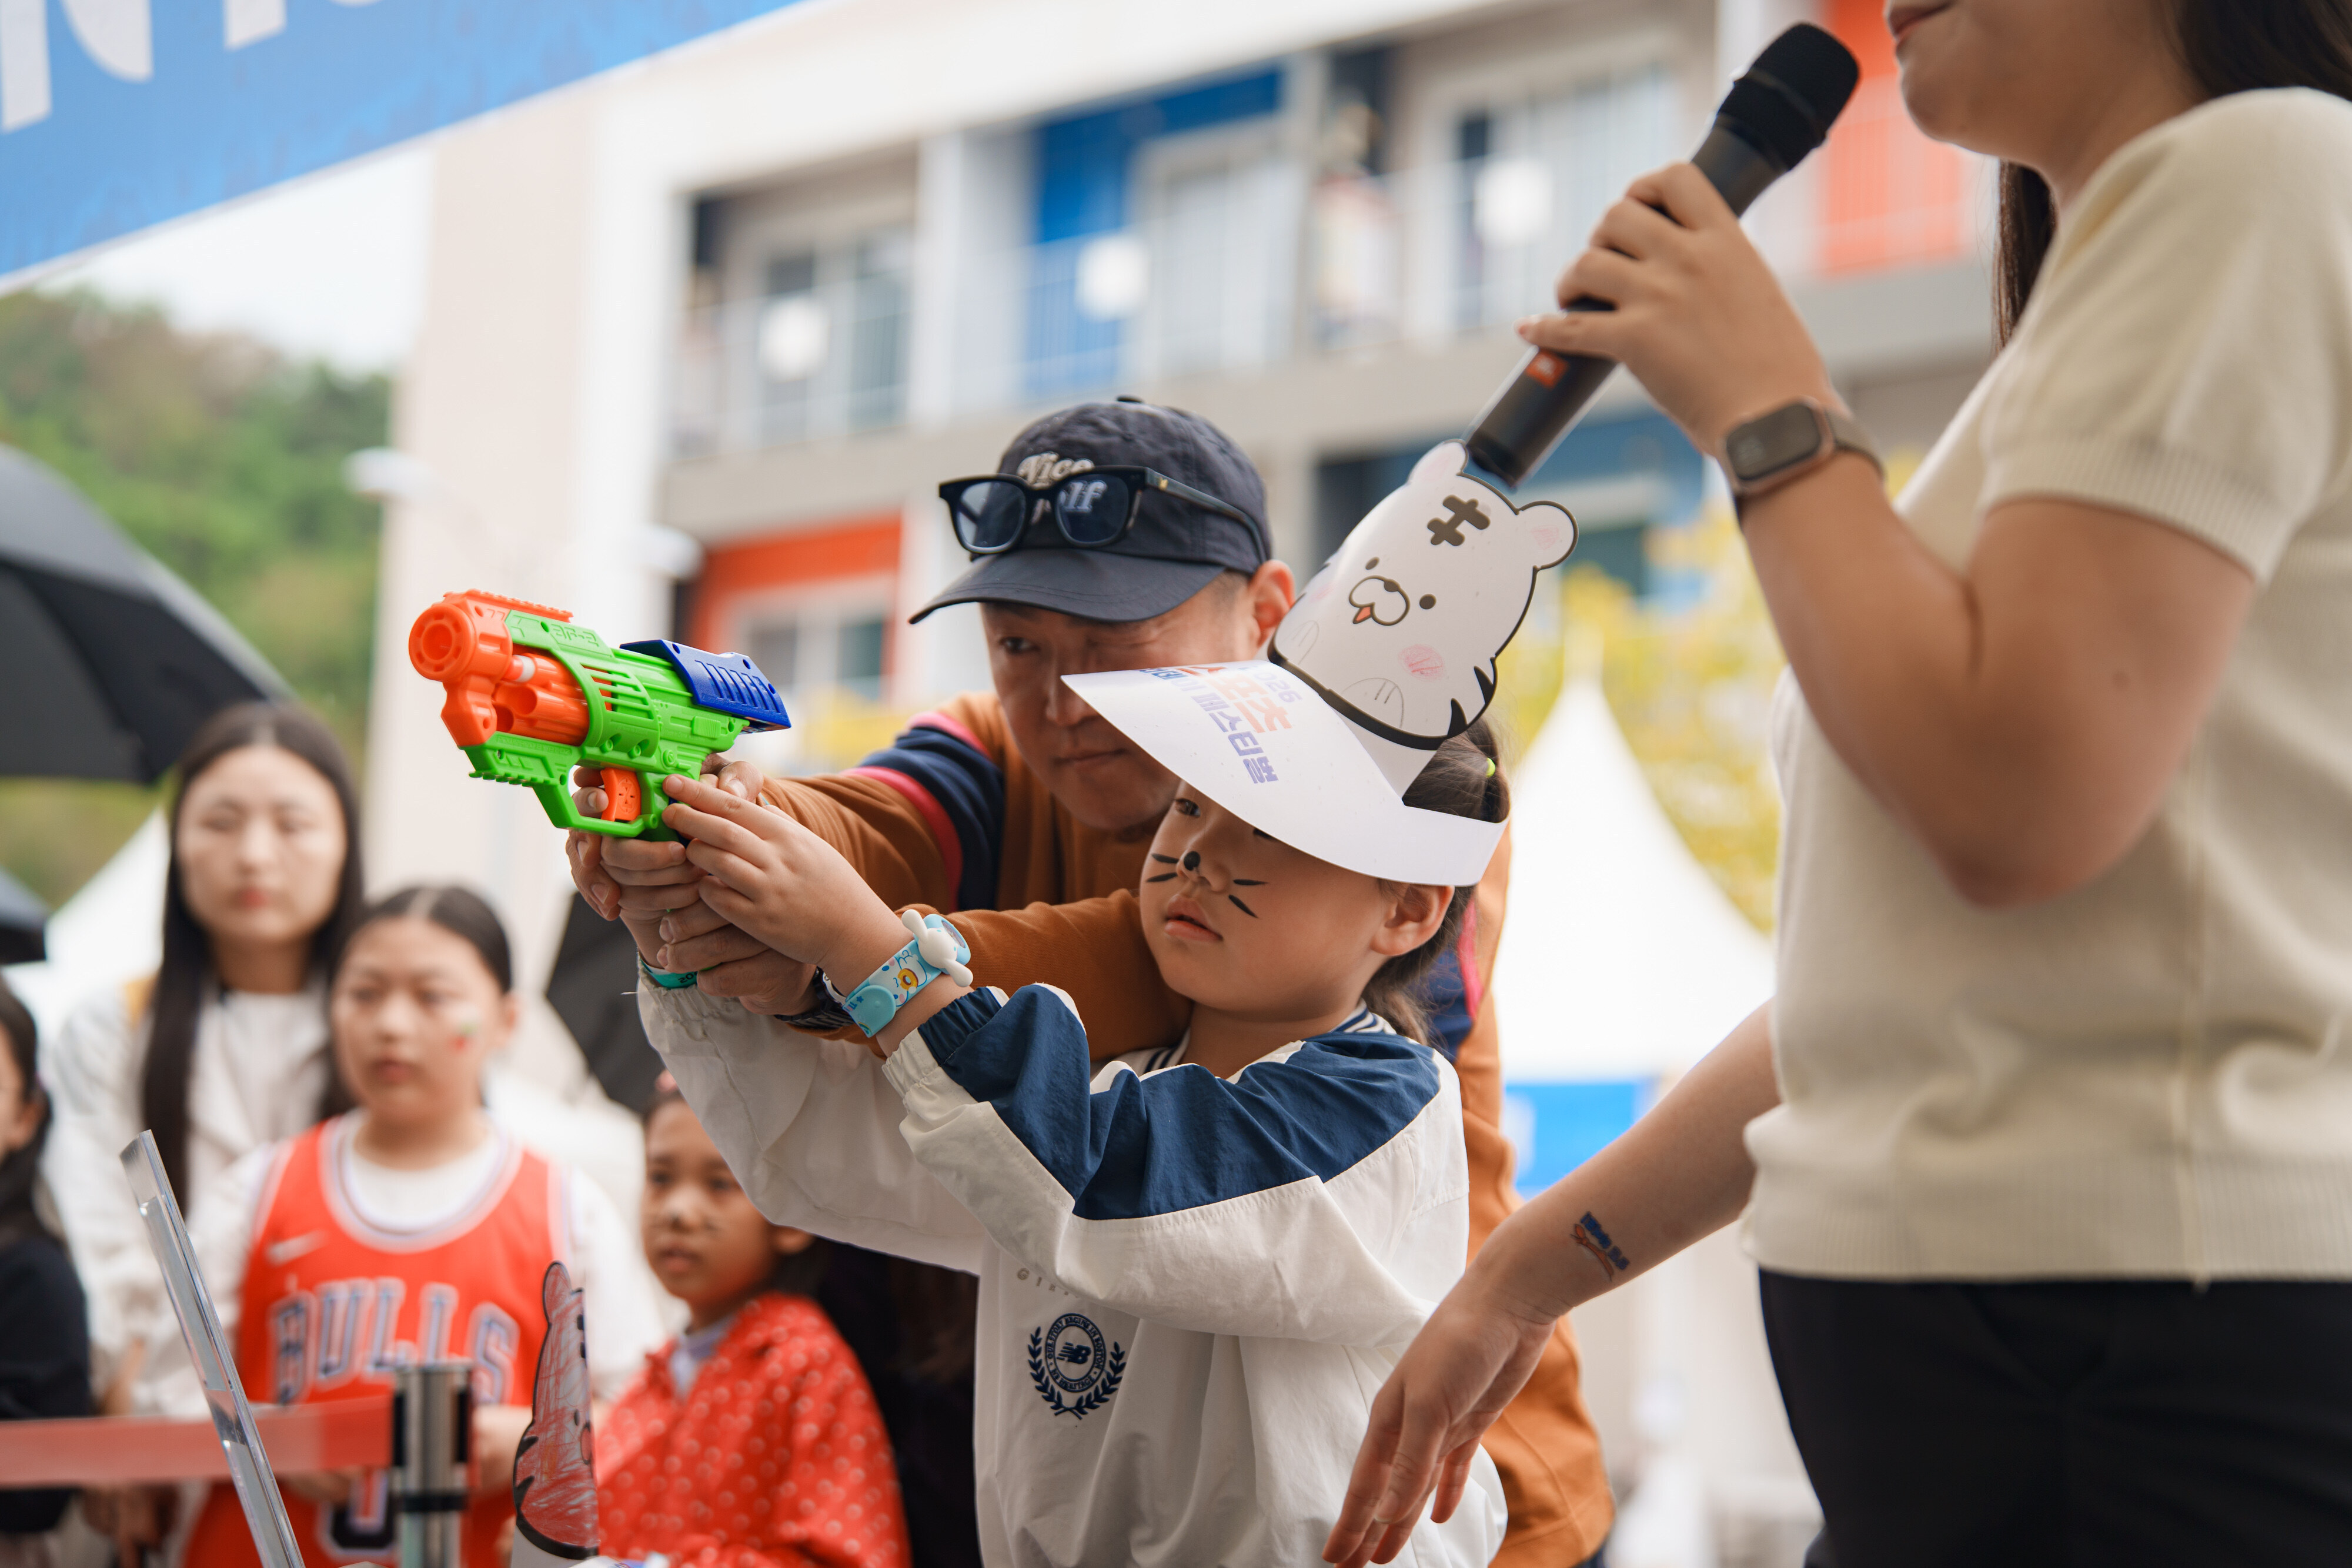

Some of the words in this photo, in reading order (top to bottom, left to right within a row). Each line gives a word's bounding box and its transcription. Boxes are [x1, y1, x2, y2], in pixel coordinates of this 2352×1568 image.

[1190, 692, 1279, 784] 페스티벌
[268, 1276, 521, 1406] BULLS
[1095, 1338, 1103, 1369] BOSTON
[1060, 1375, 1095, 1389] HERITAGE
